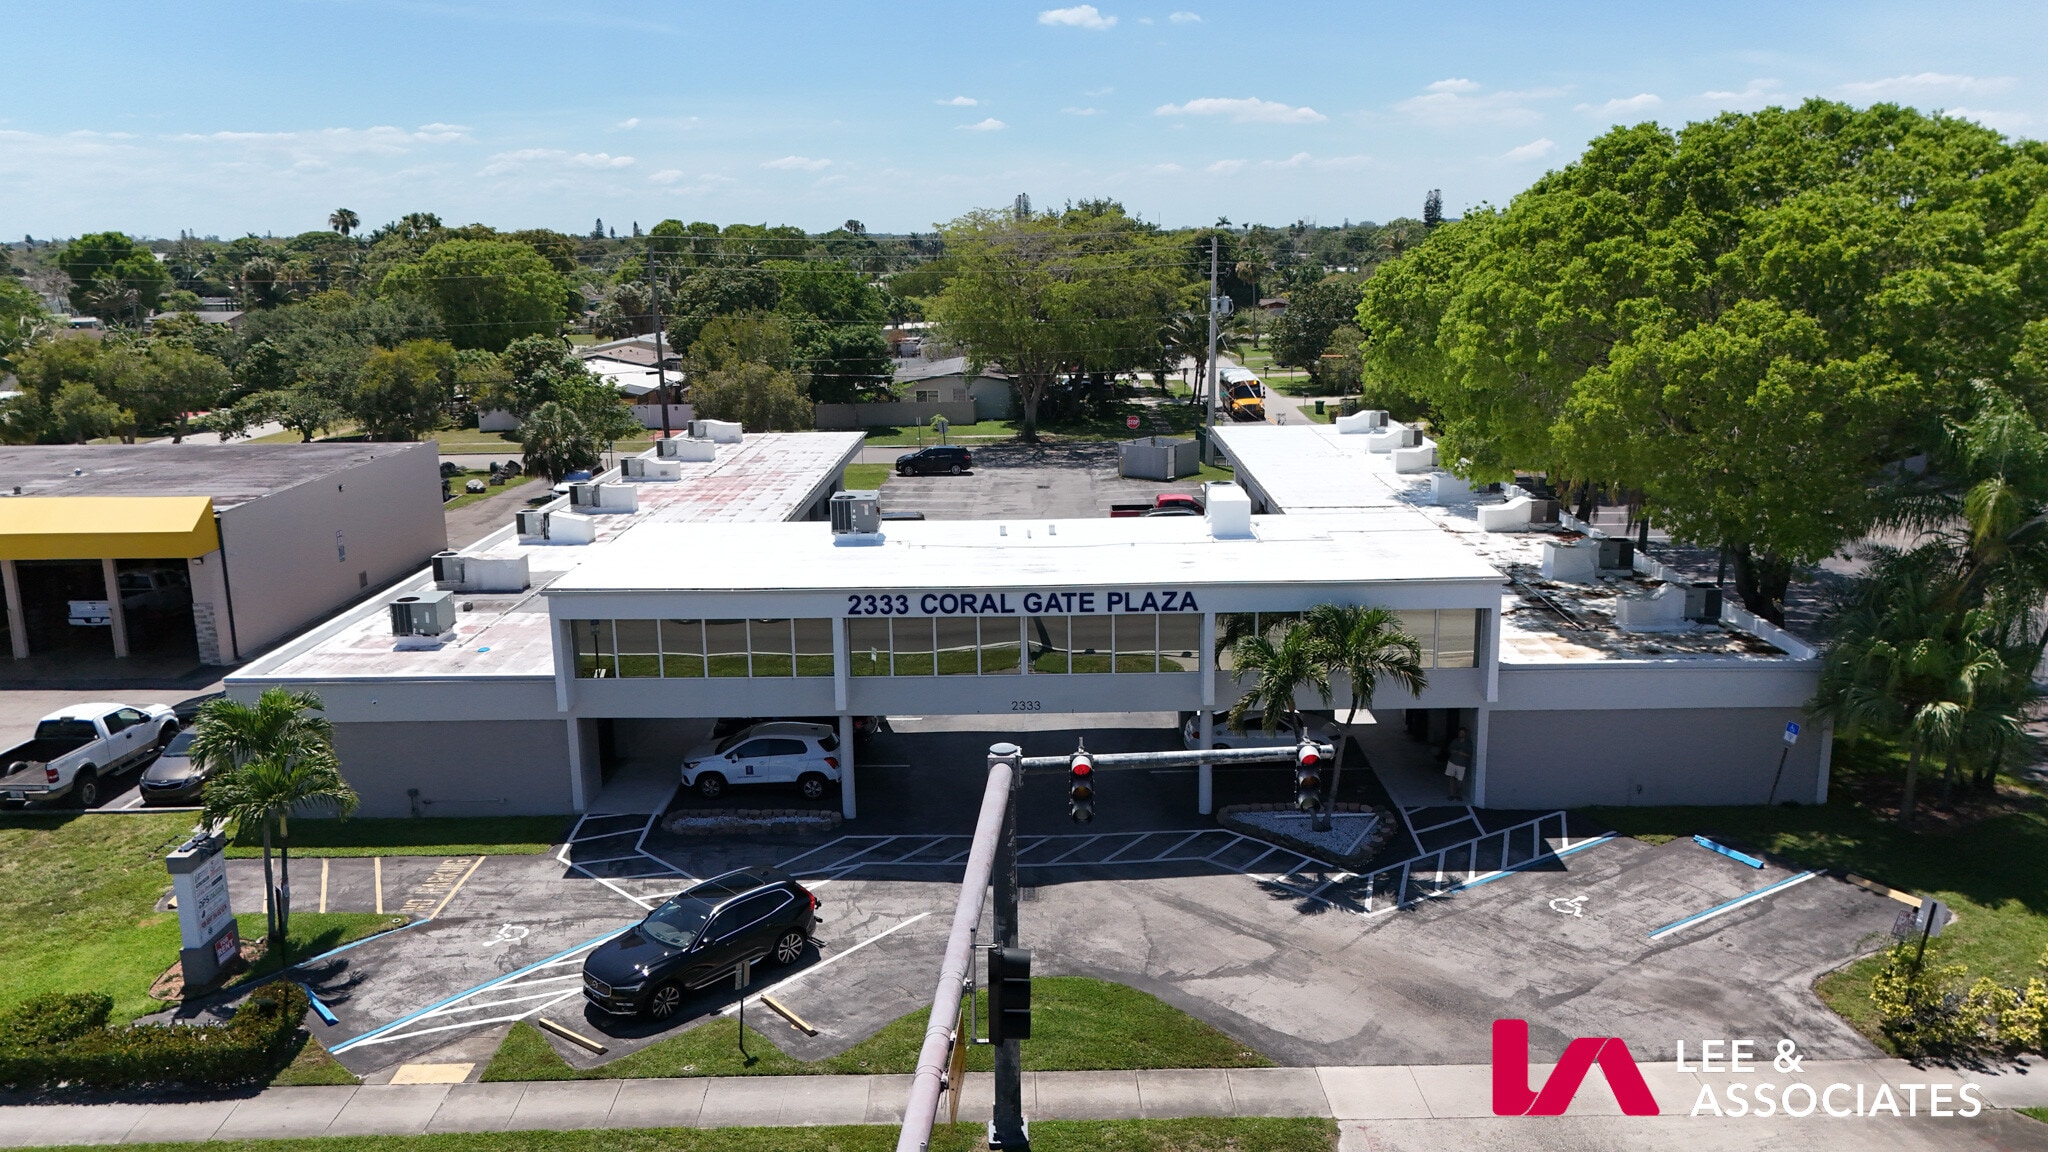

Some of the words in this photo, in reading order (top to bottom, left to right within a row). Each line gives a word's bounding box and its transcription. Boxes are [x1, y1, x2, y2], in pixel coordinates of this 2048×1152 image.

[848, 594, 909, 615] 2333
[920, 593, 1015, 614] CORAL
[1023, 592, 1095, 613] GATE
[1107, 591, 1199, 613] PLAZA
[1011, 700, 1041, 711] 2333
[414, 859, 472, 895] PARKING
[400, 899, 437, 912] NO
[217, 939, 234, 956] RENT
